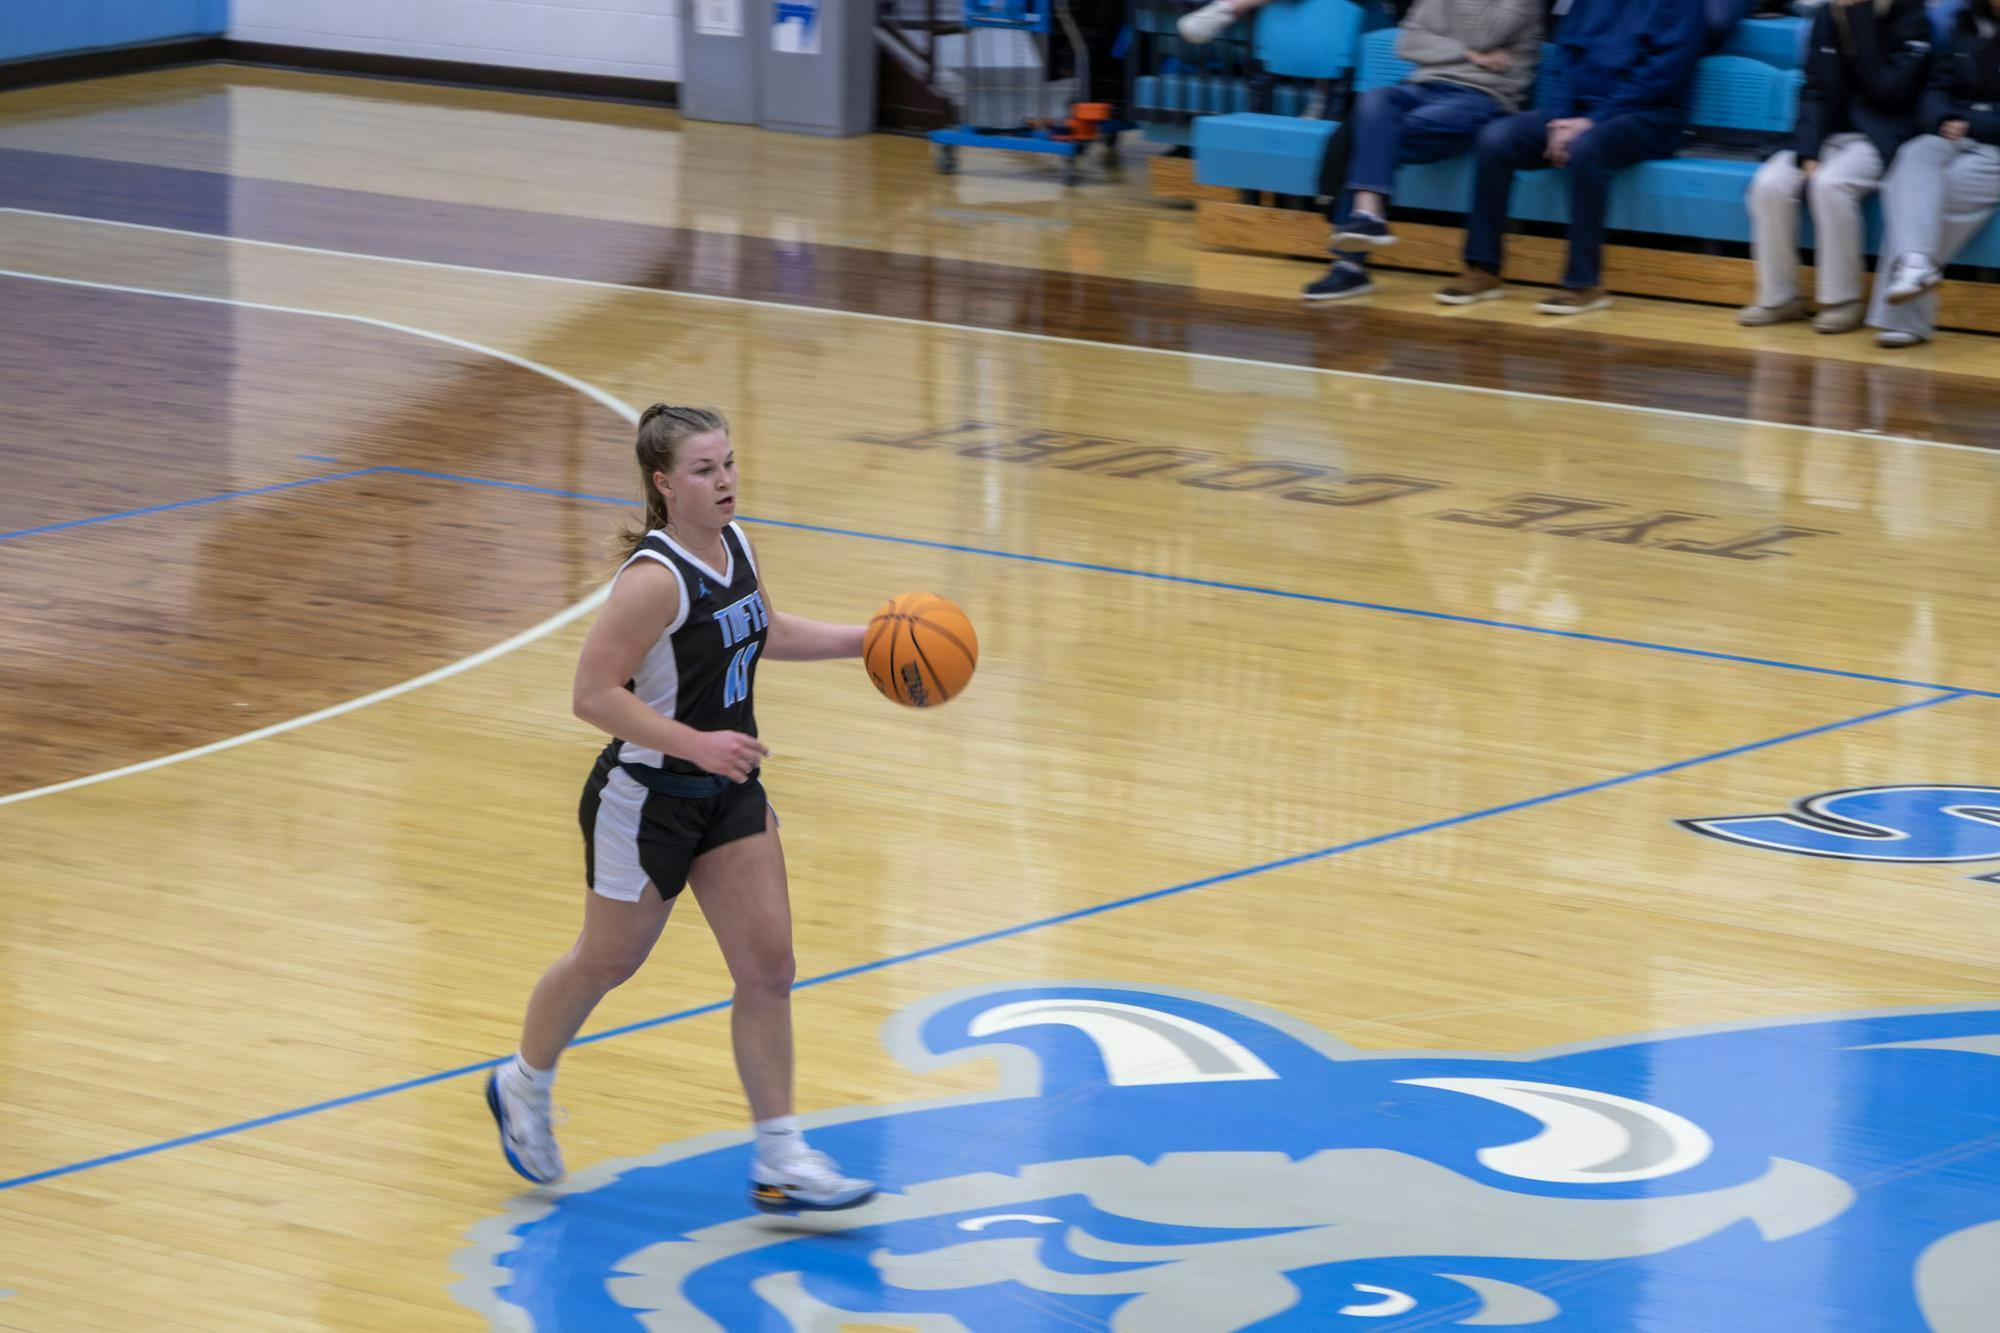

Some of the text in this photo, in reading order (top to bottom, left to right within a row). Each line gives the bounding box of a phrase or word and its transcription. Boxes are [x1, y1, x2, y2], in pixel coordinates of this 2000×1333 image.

[850, 420, 1840, 561] TYE COURT
[724, 641, 759, 708] 11
